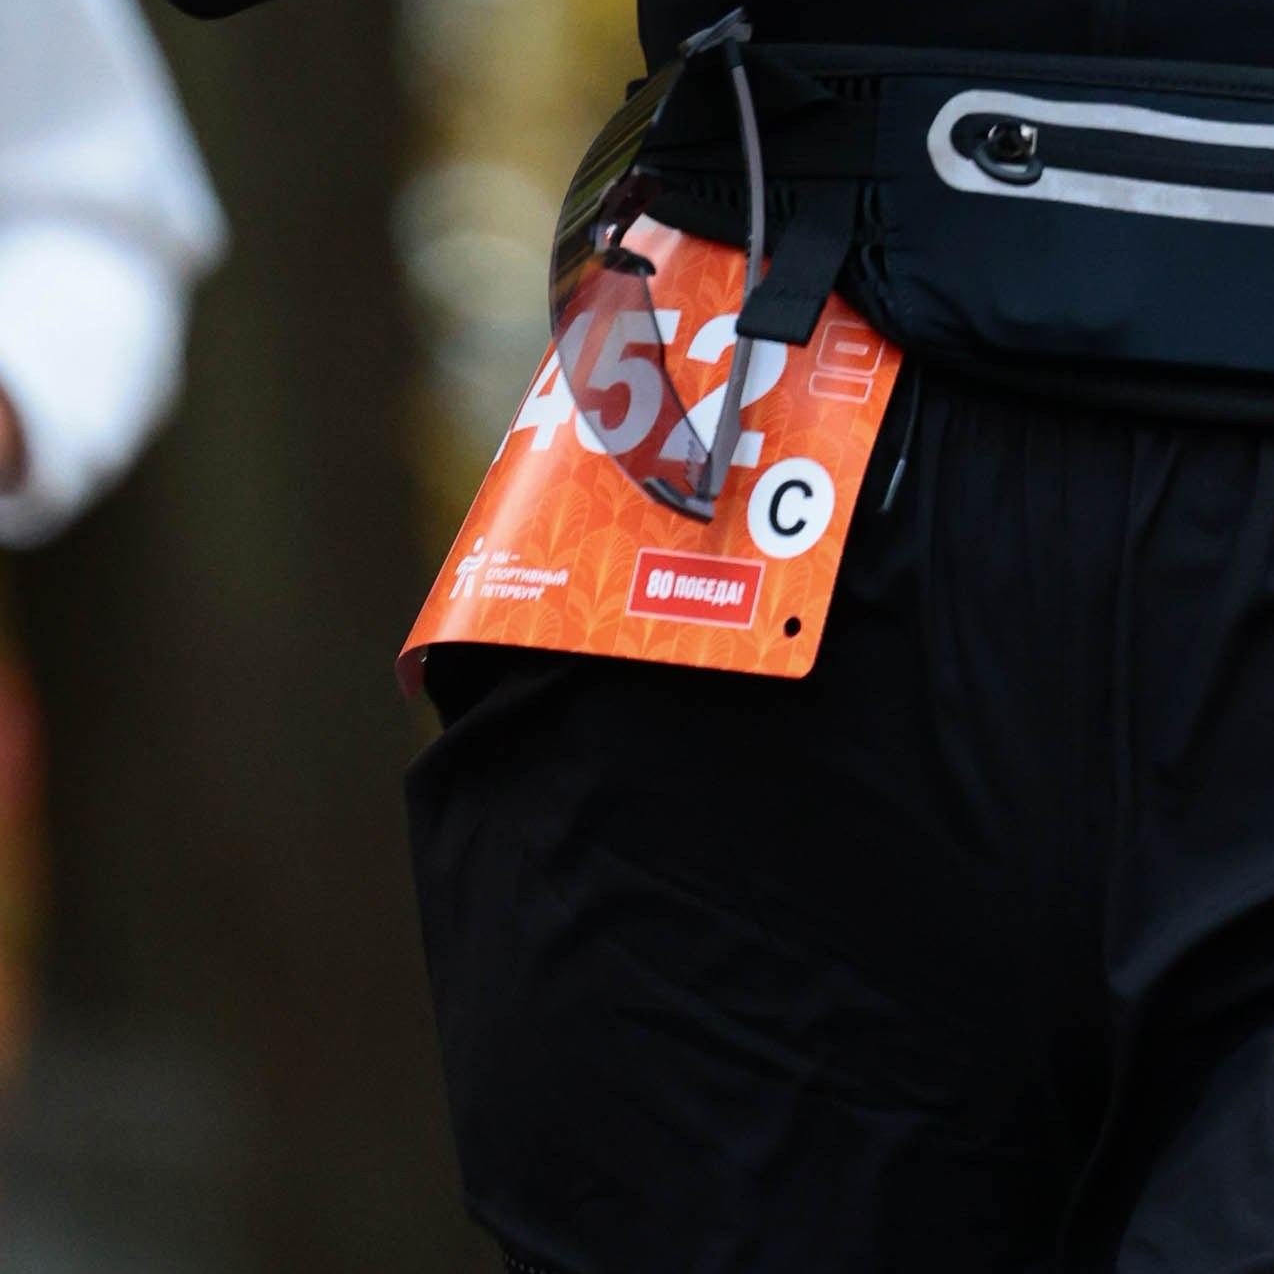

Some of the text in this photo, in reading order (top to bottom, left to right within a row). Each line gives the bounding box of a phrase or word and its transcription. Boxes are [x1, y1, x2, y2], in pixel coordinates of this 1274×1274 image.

[494, 308, 788, 469] 452
[480, 583, 545, 601] ПЕТЕРБУРГ
[646, 568, 745, 606] 80 ПОБЕДА!
